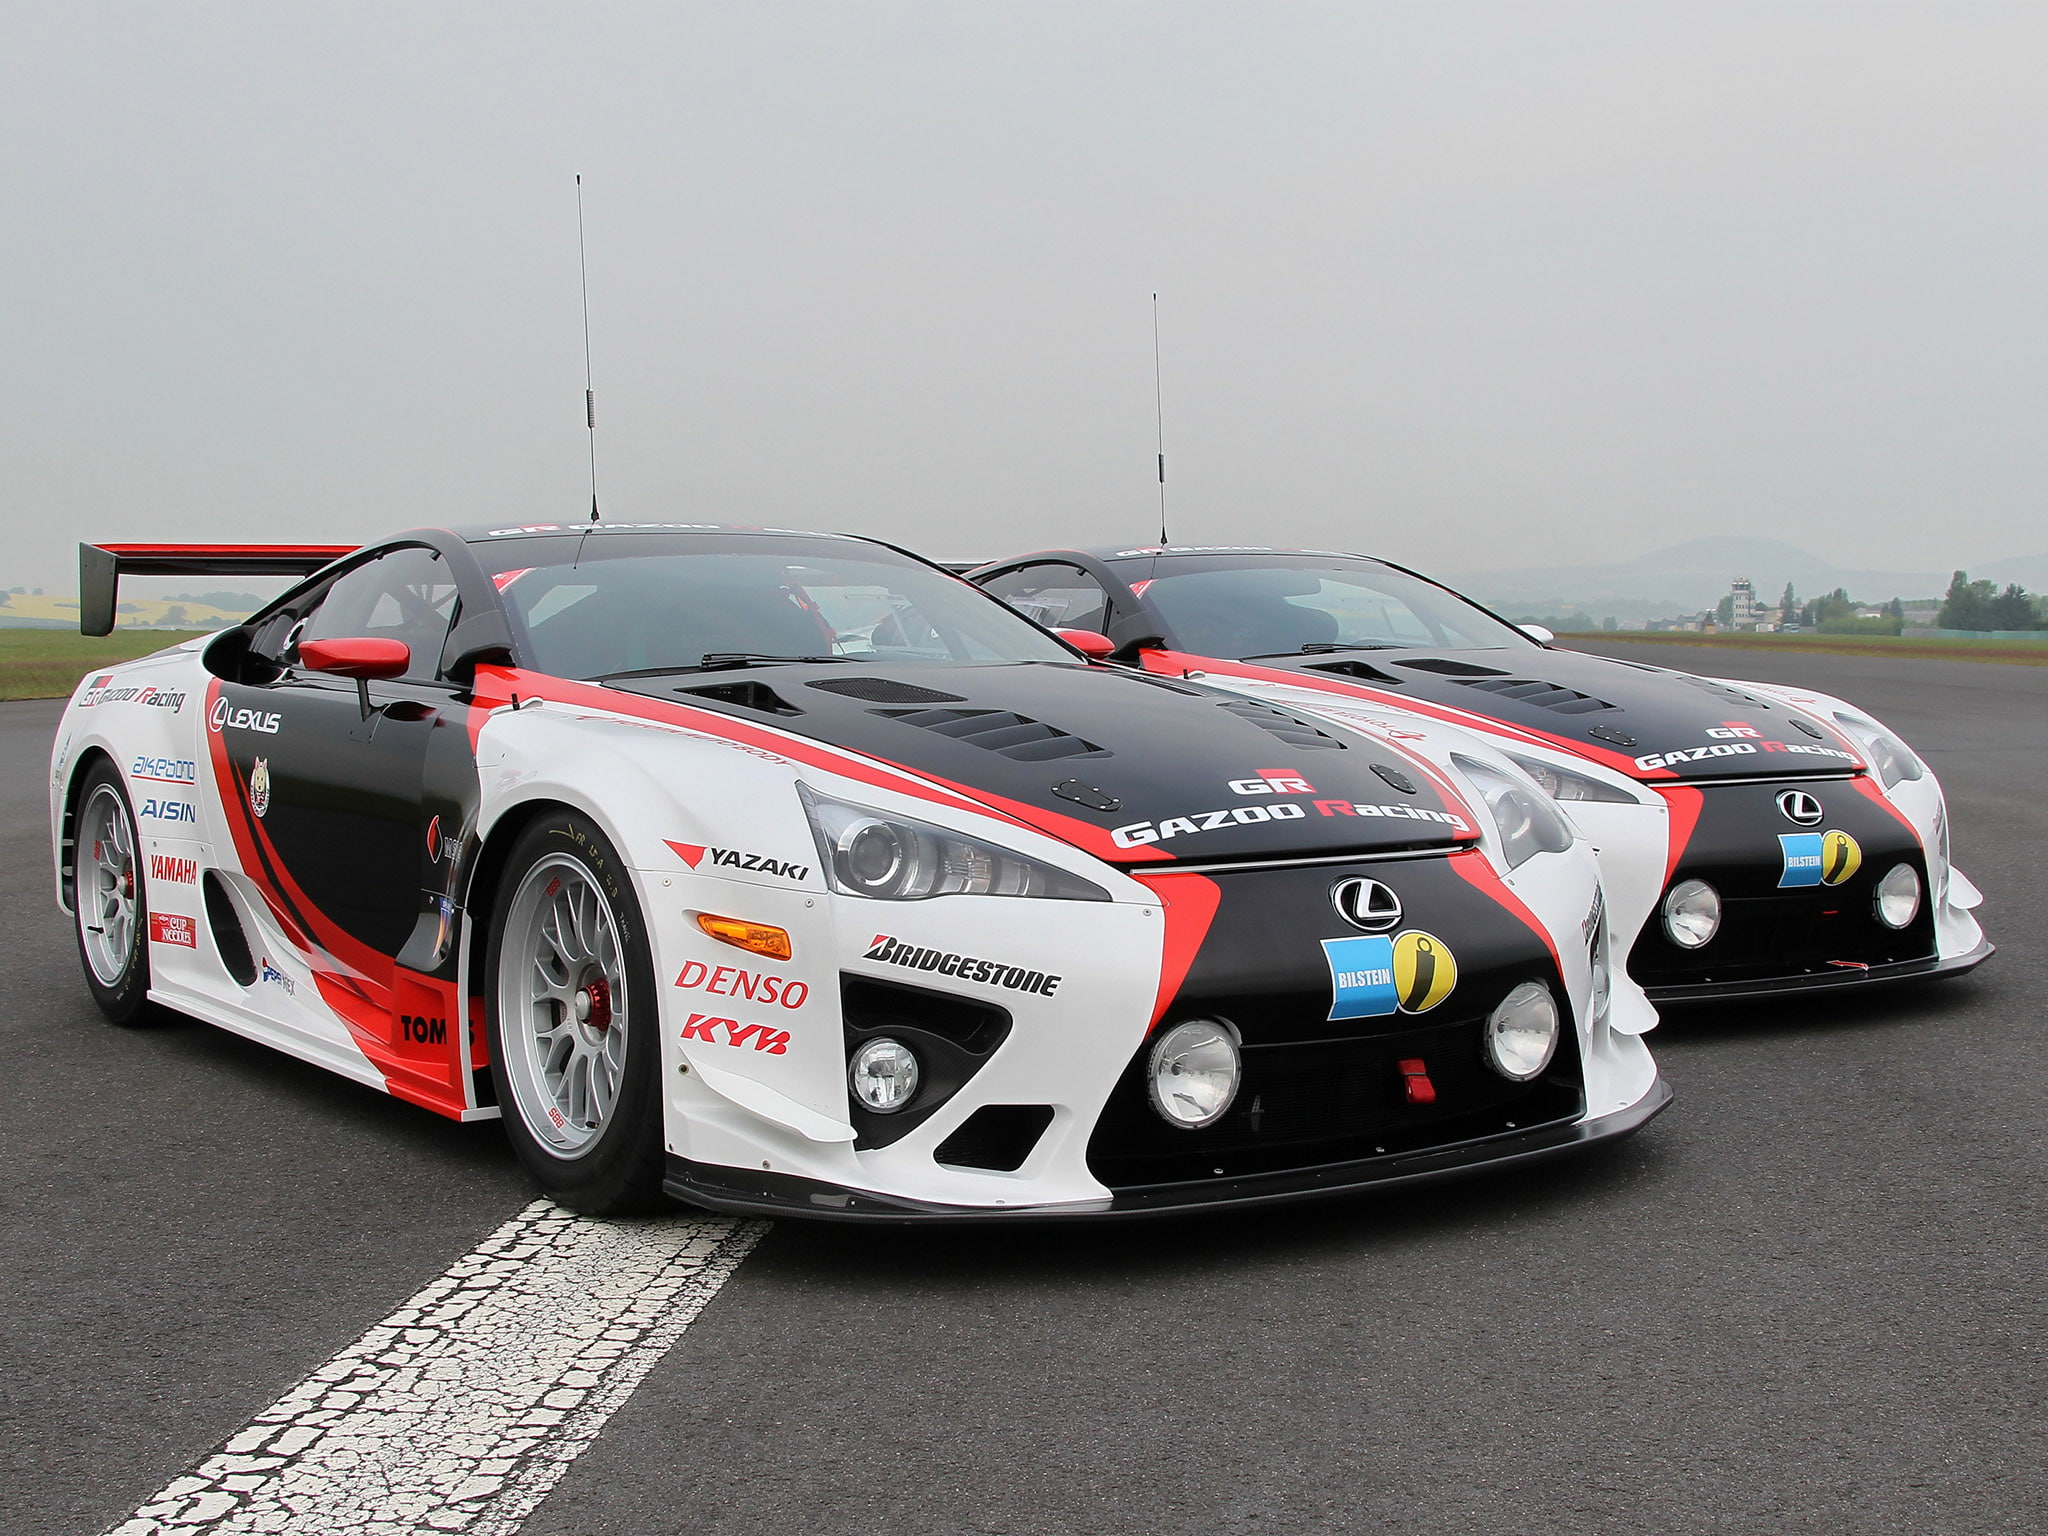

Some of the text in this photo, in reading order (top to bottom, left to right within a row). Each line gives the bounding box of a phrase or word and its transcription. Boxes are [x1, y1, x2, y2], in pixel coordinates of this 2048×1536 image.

[133, 687, 186, 713] Racing
[228, 707, 282, 734] LEXUS
[1705, 727, 1763, 739] GR
[1634, 740, 1862, 771] GAZOO Racing
[1227, 777, 1315, 795] GR
[140, 799, 196, 823] AISIN
[1110, 800, 1471, 849] GAZOO Racing
[151, 854, 197, 885] YAMAHA
[707, 847, 809, 881] YAZAKI
[1787, 855, 1821, 869] BILSTEIN
[170, 917, 187, 931] CUP
[862, 934, 1063, 998] BRIDGESTONE
[1338, 968, 1391, 989] BILSTEIN
[674, 960, 808, 1009] DENSO
[680, 1013, 791, 1055] KYB
